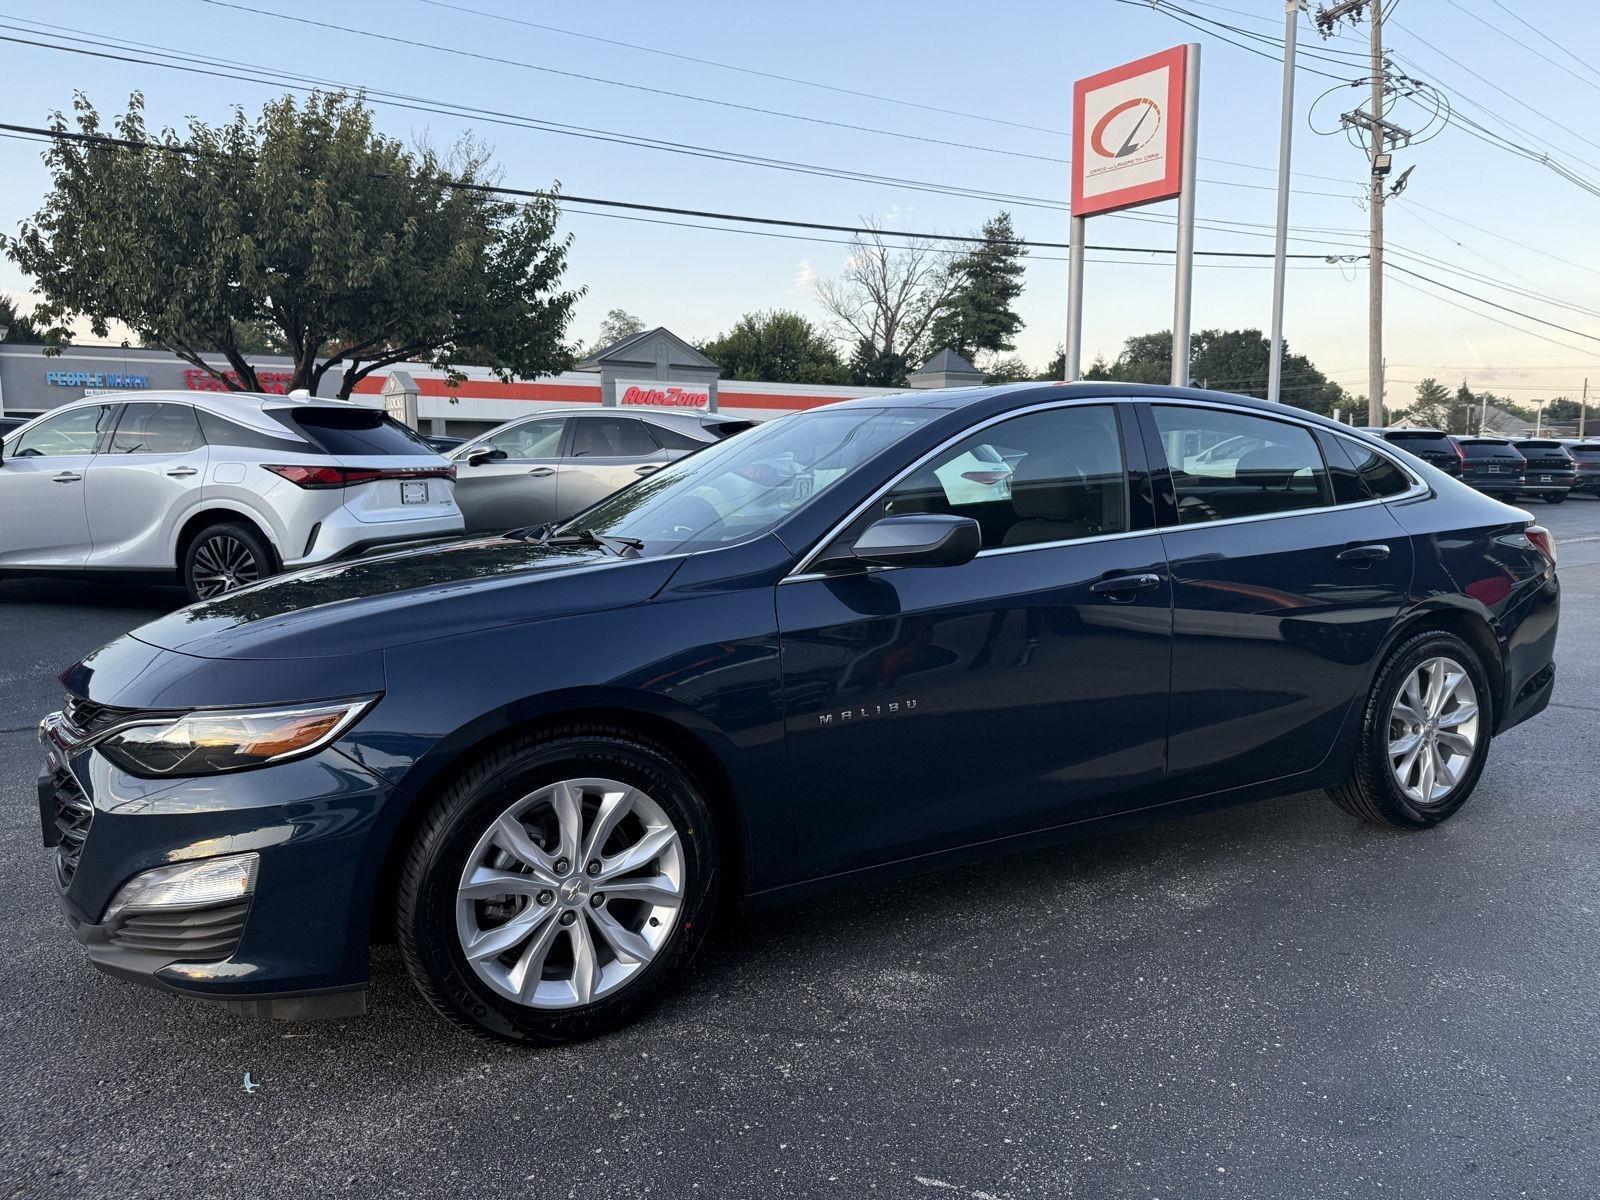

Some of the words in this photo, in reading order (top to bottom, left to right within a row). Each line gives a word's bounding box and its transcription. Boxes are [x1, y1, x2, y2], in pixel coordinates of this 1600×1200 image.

[47, 370, 103, 387] PEOPLE
[621, 386, 708, 407] AutoZone
[818, 699, 917, 724] MALIBU
